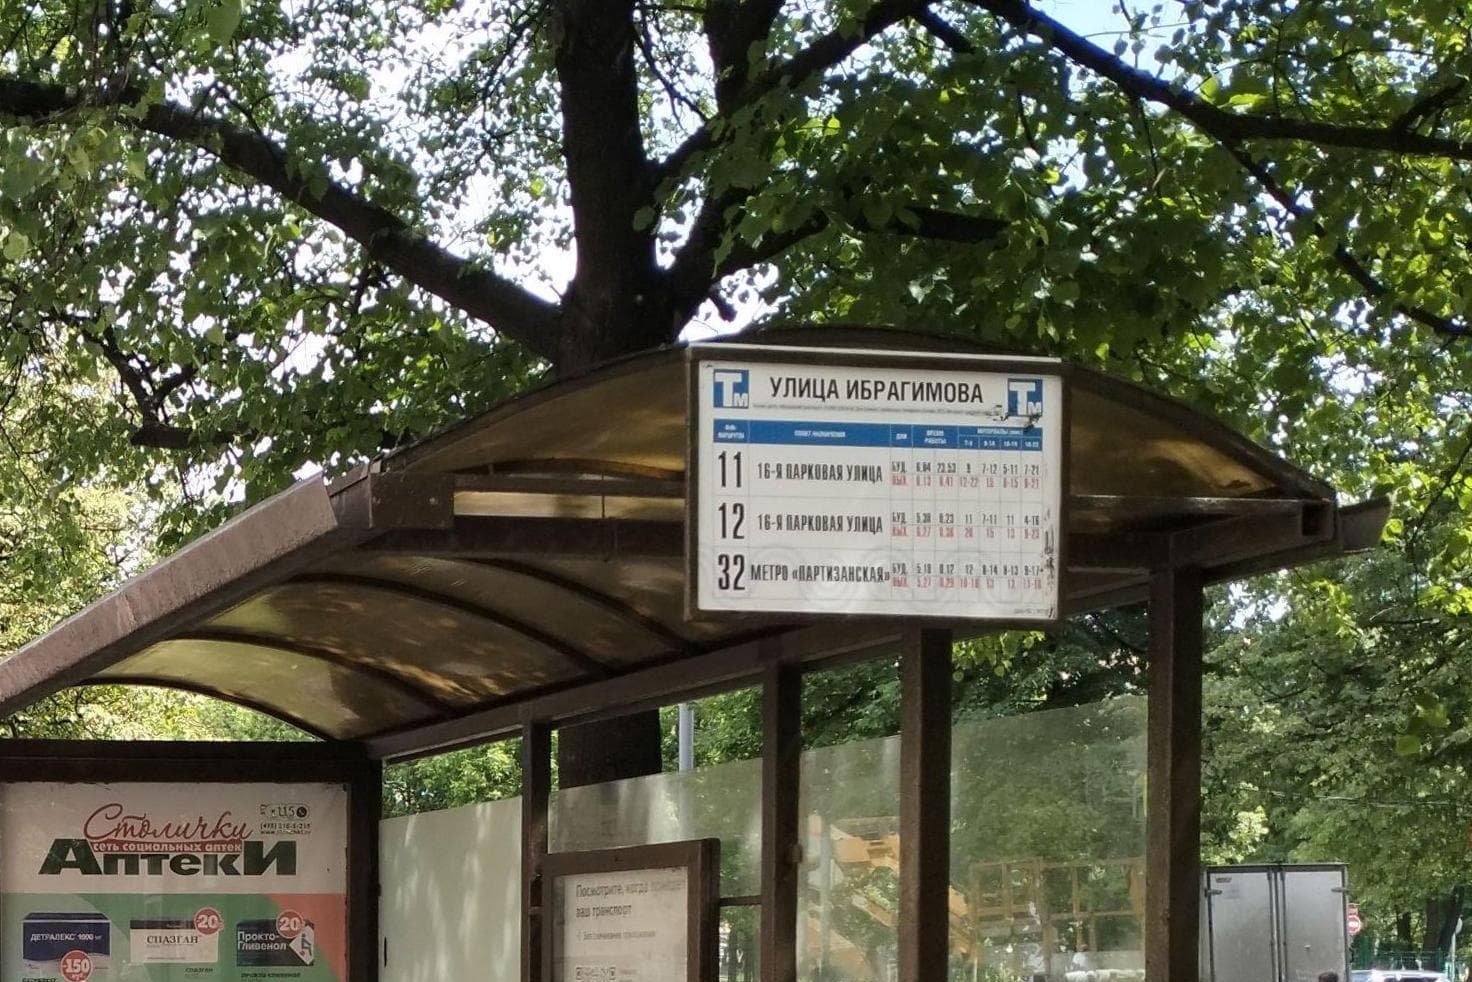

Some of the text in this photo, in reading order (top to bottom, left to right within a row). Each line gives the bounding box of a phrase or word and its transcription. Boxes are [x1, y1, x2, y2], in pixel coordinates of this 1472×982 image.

[769, 376, 984, 404] УЛИЦА ИБРАГИМОВА
[718, 450, 742, 488] 11
[757, 462, 883, 483] 16-Я ПАРКОВАЯ УЛИЦА
[718, 502, 745, 539] 12
[757, 513, 883, 535] 16-Я ПАРКОВАЯ УЛИЦА
[717, 553, 746, 590] 32
[750, 564, 891, 583] МЕТРО «ПАРТИЗАНСКАЯ»
[84, 803, 255, 841] Столички
[93, 841, 242, 853] сеть социальных аптек
[146, 935, 199, 944] СПАЗГАН
[237, 931, 280, 942] Прокто-
[237, 941, 287, 951] Гливенол
